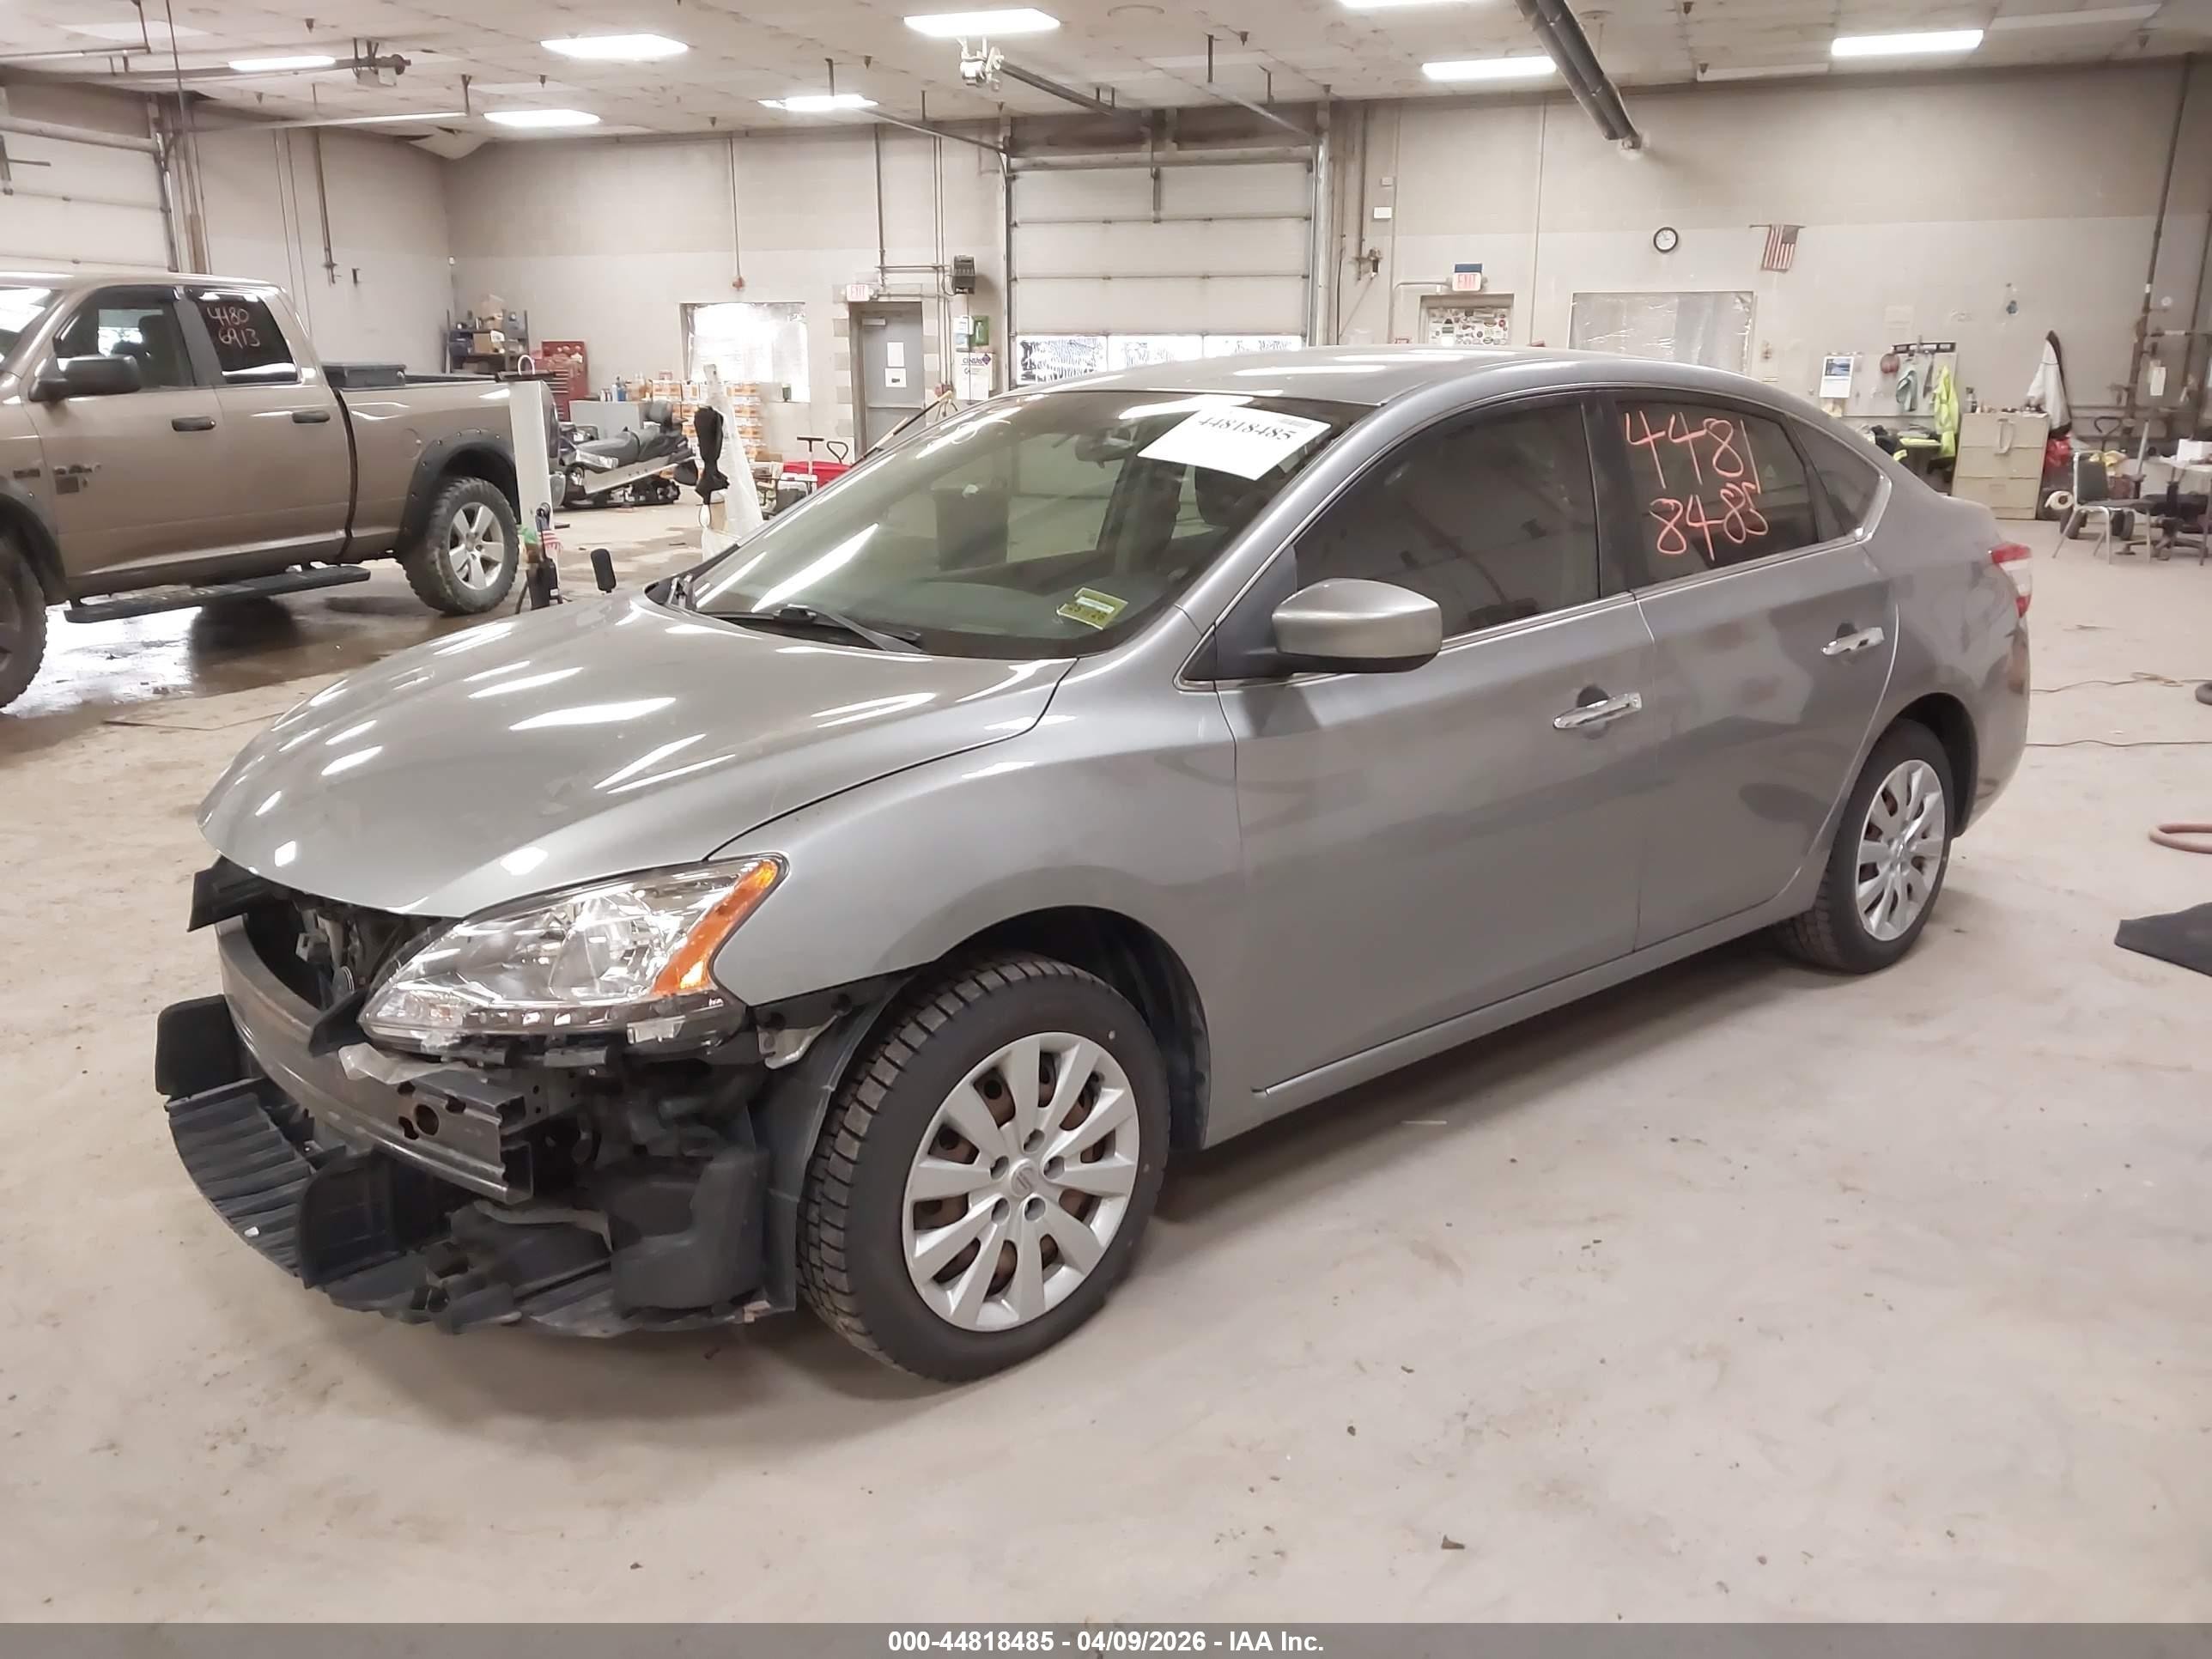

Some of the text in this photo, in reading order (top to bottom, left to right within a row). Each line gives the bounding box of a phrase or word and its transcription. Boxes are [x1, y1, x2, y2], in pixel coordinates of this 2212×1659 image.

[1458, 274, 1478, 289] EXIT
[206, 306, 250, 326] 4480
[218, 327, 261, 349] 6913
[1199, 417, 1297, 440] 44818485
[1626, 410, 1761, 494] 4481
[1649, 483, 1769, 562] 8485
